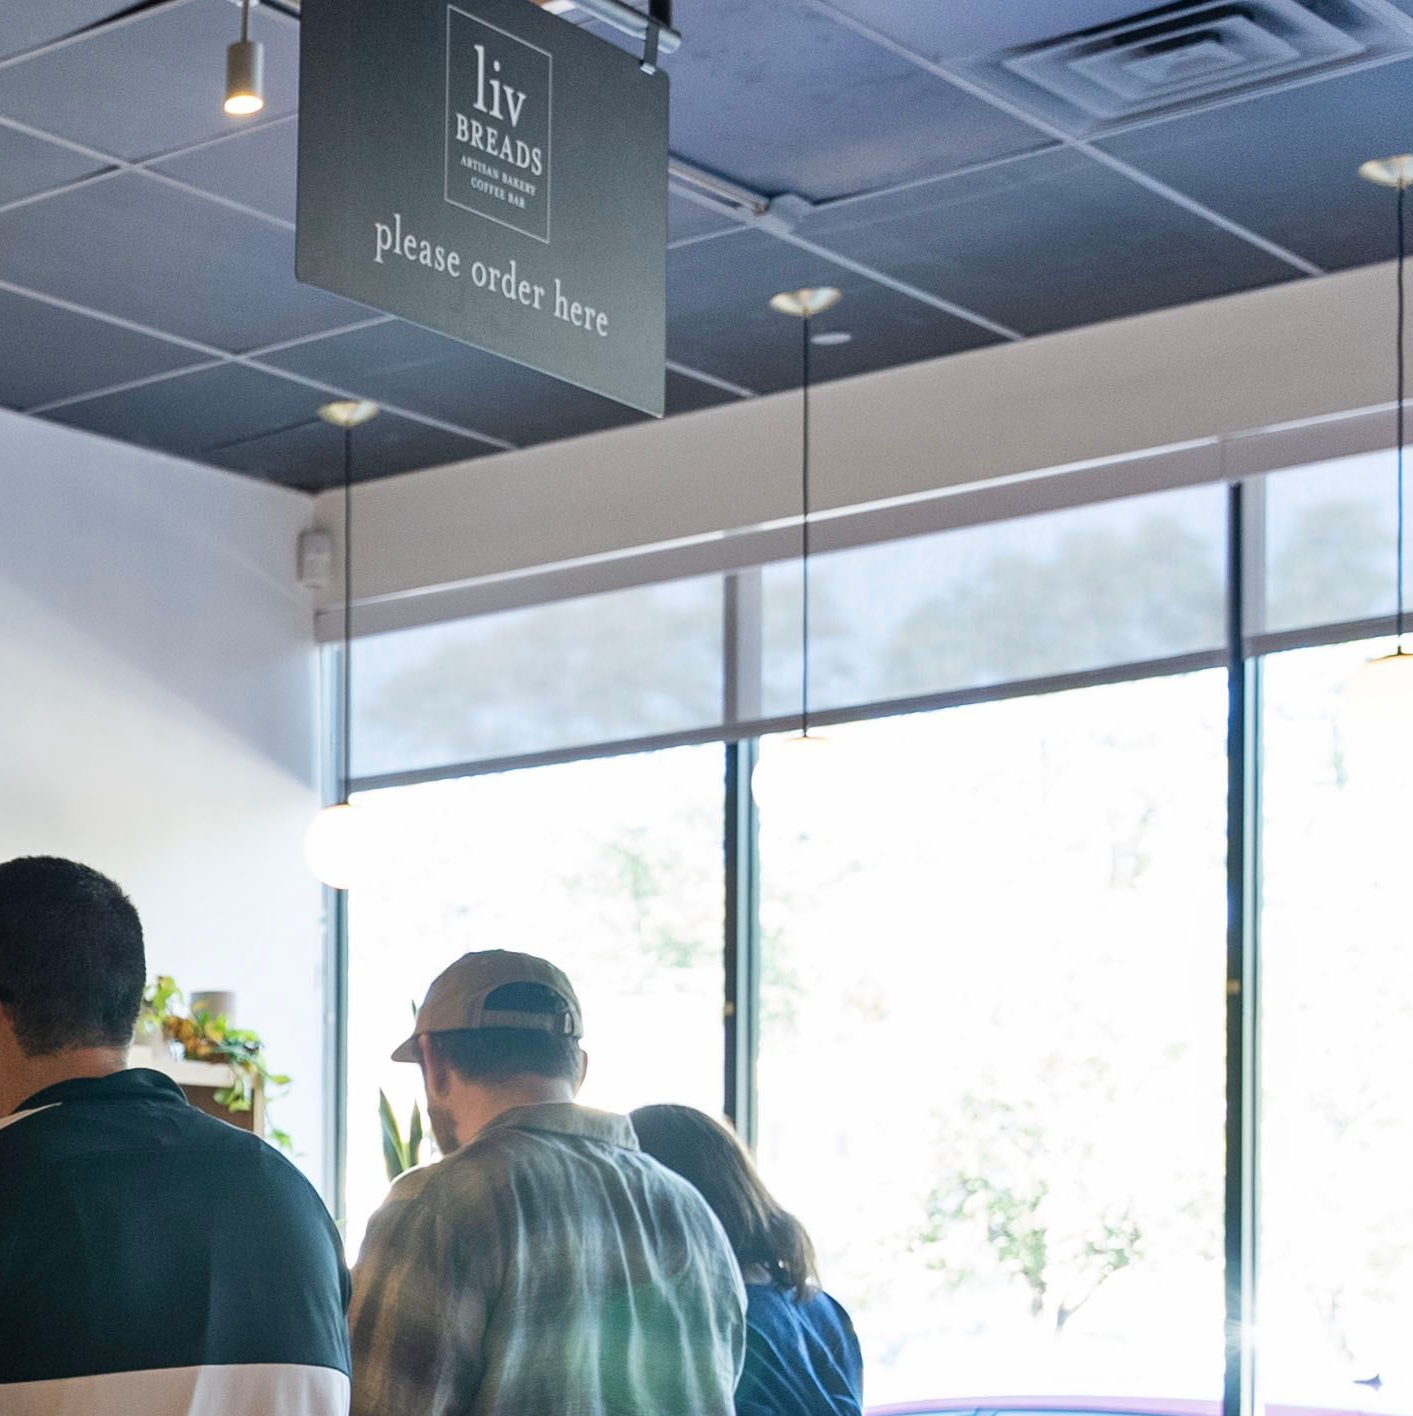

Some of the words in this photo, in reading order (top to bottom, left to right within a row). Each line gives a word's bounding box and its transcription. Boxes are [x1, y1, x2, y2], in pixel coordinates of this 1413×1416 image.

[474, 44, 527, 128] liv
[455, 112, 542, 176] BREADS
[461, 155, 499, 179] ARTISAN
[501, 172, 536, 196] BAKERY
[471, 176, 505, 200] COFFEE
[508, 192, 525, 209] BAR
[374, 213, 461, 277] please
[471, 260, 545, 310] order
[555, 279, 609, 337] here
